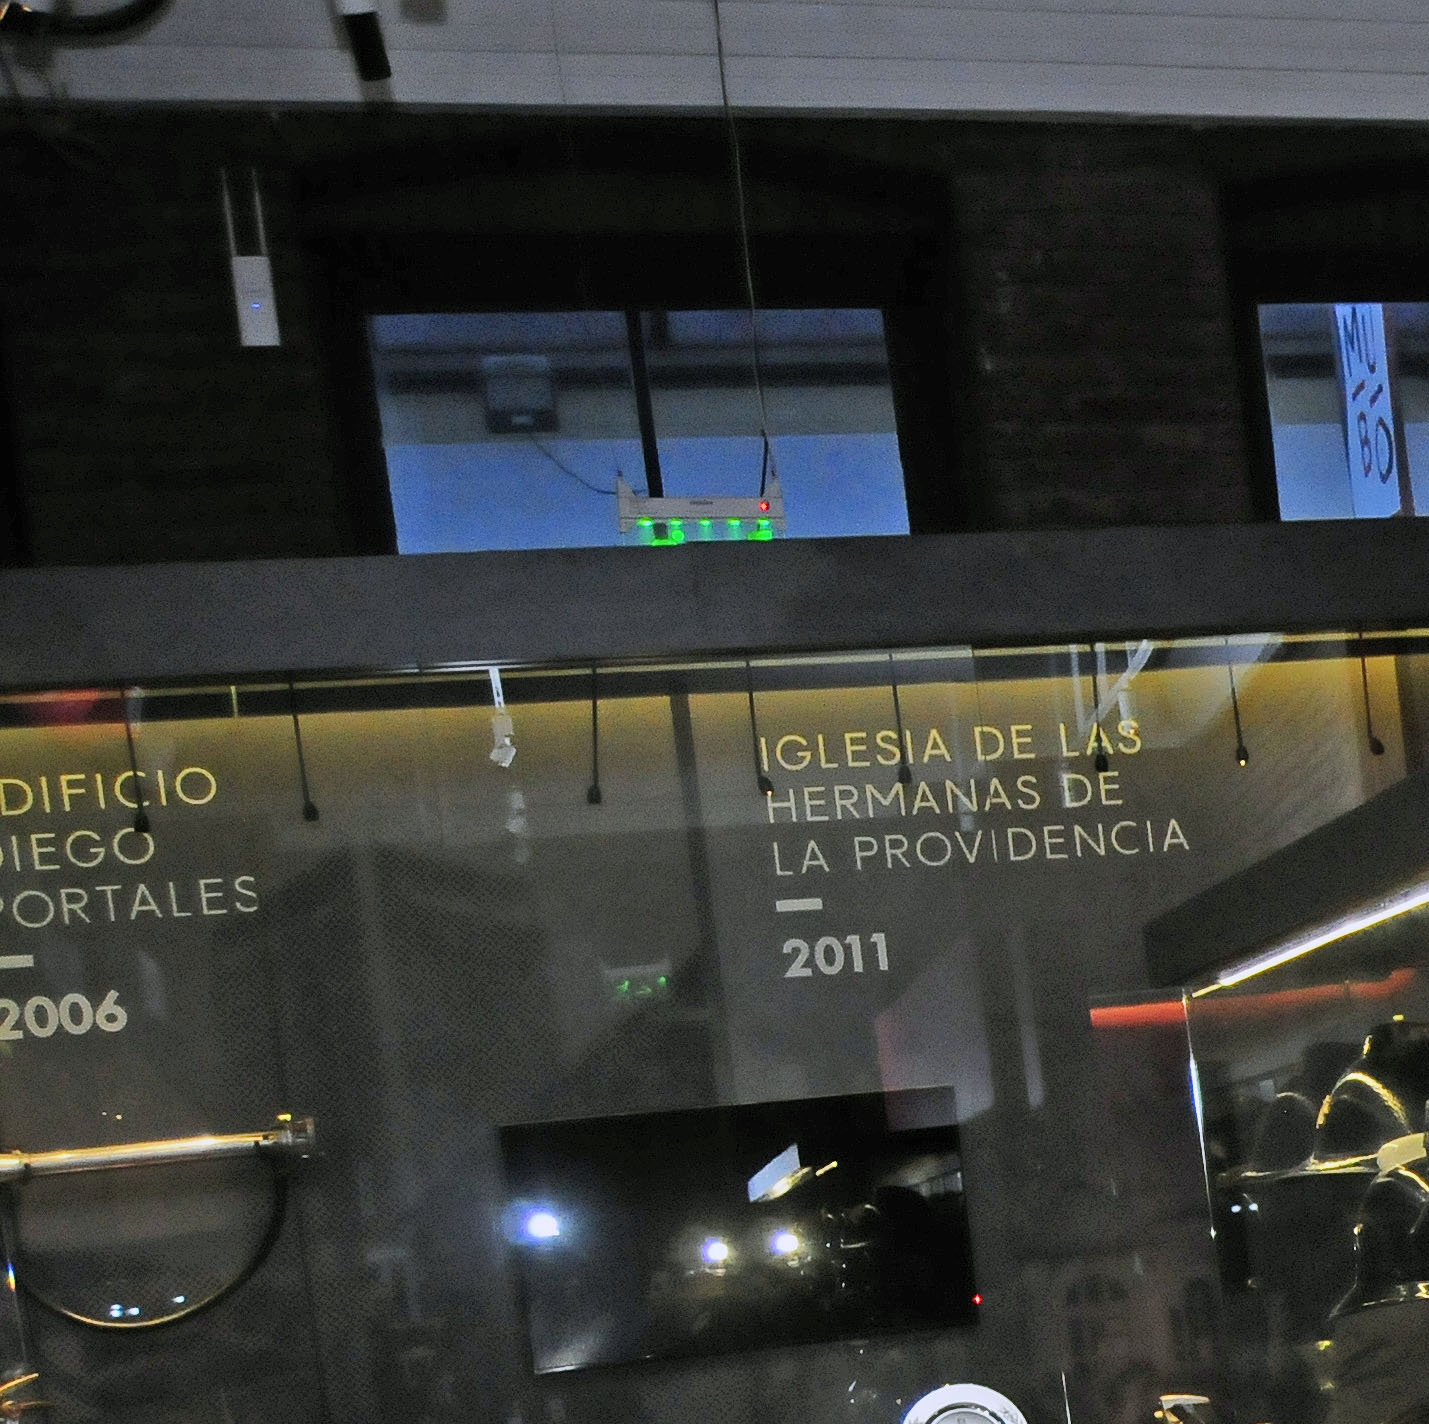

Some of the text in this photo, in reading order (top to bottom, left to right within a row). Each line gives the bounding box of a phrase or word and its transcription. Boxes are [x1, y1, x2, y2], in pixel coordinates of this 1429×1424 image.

[760, 718, 1143, 772] IGLESIA DE LAS
[767, 770, 1124, 823] HERMANAS DE
[0, 827, 156, 873] IEGO
[773, 818, 1190, 876] LA PROVIDENCIA
[0, 875, 259, 929] ORTALES
[783, 932, 890, 978] 2011
[0, 990, 128, 1041] 2006
